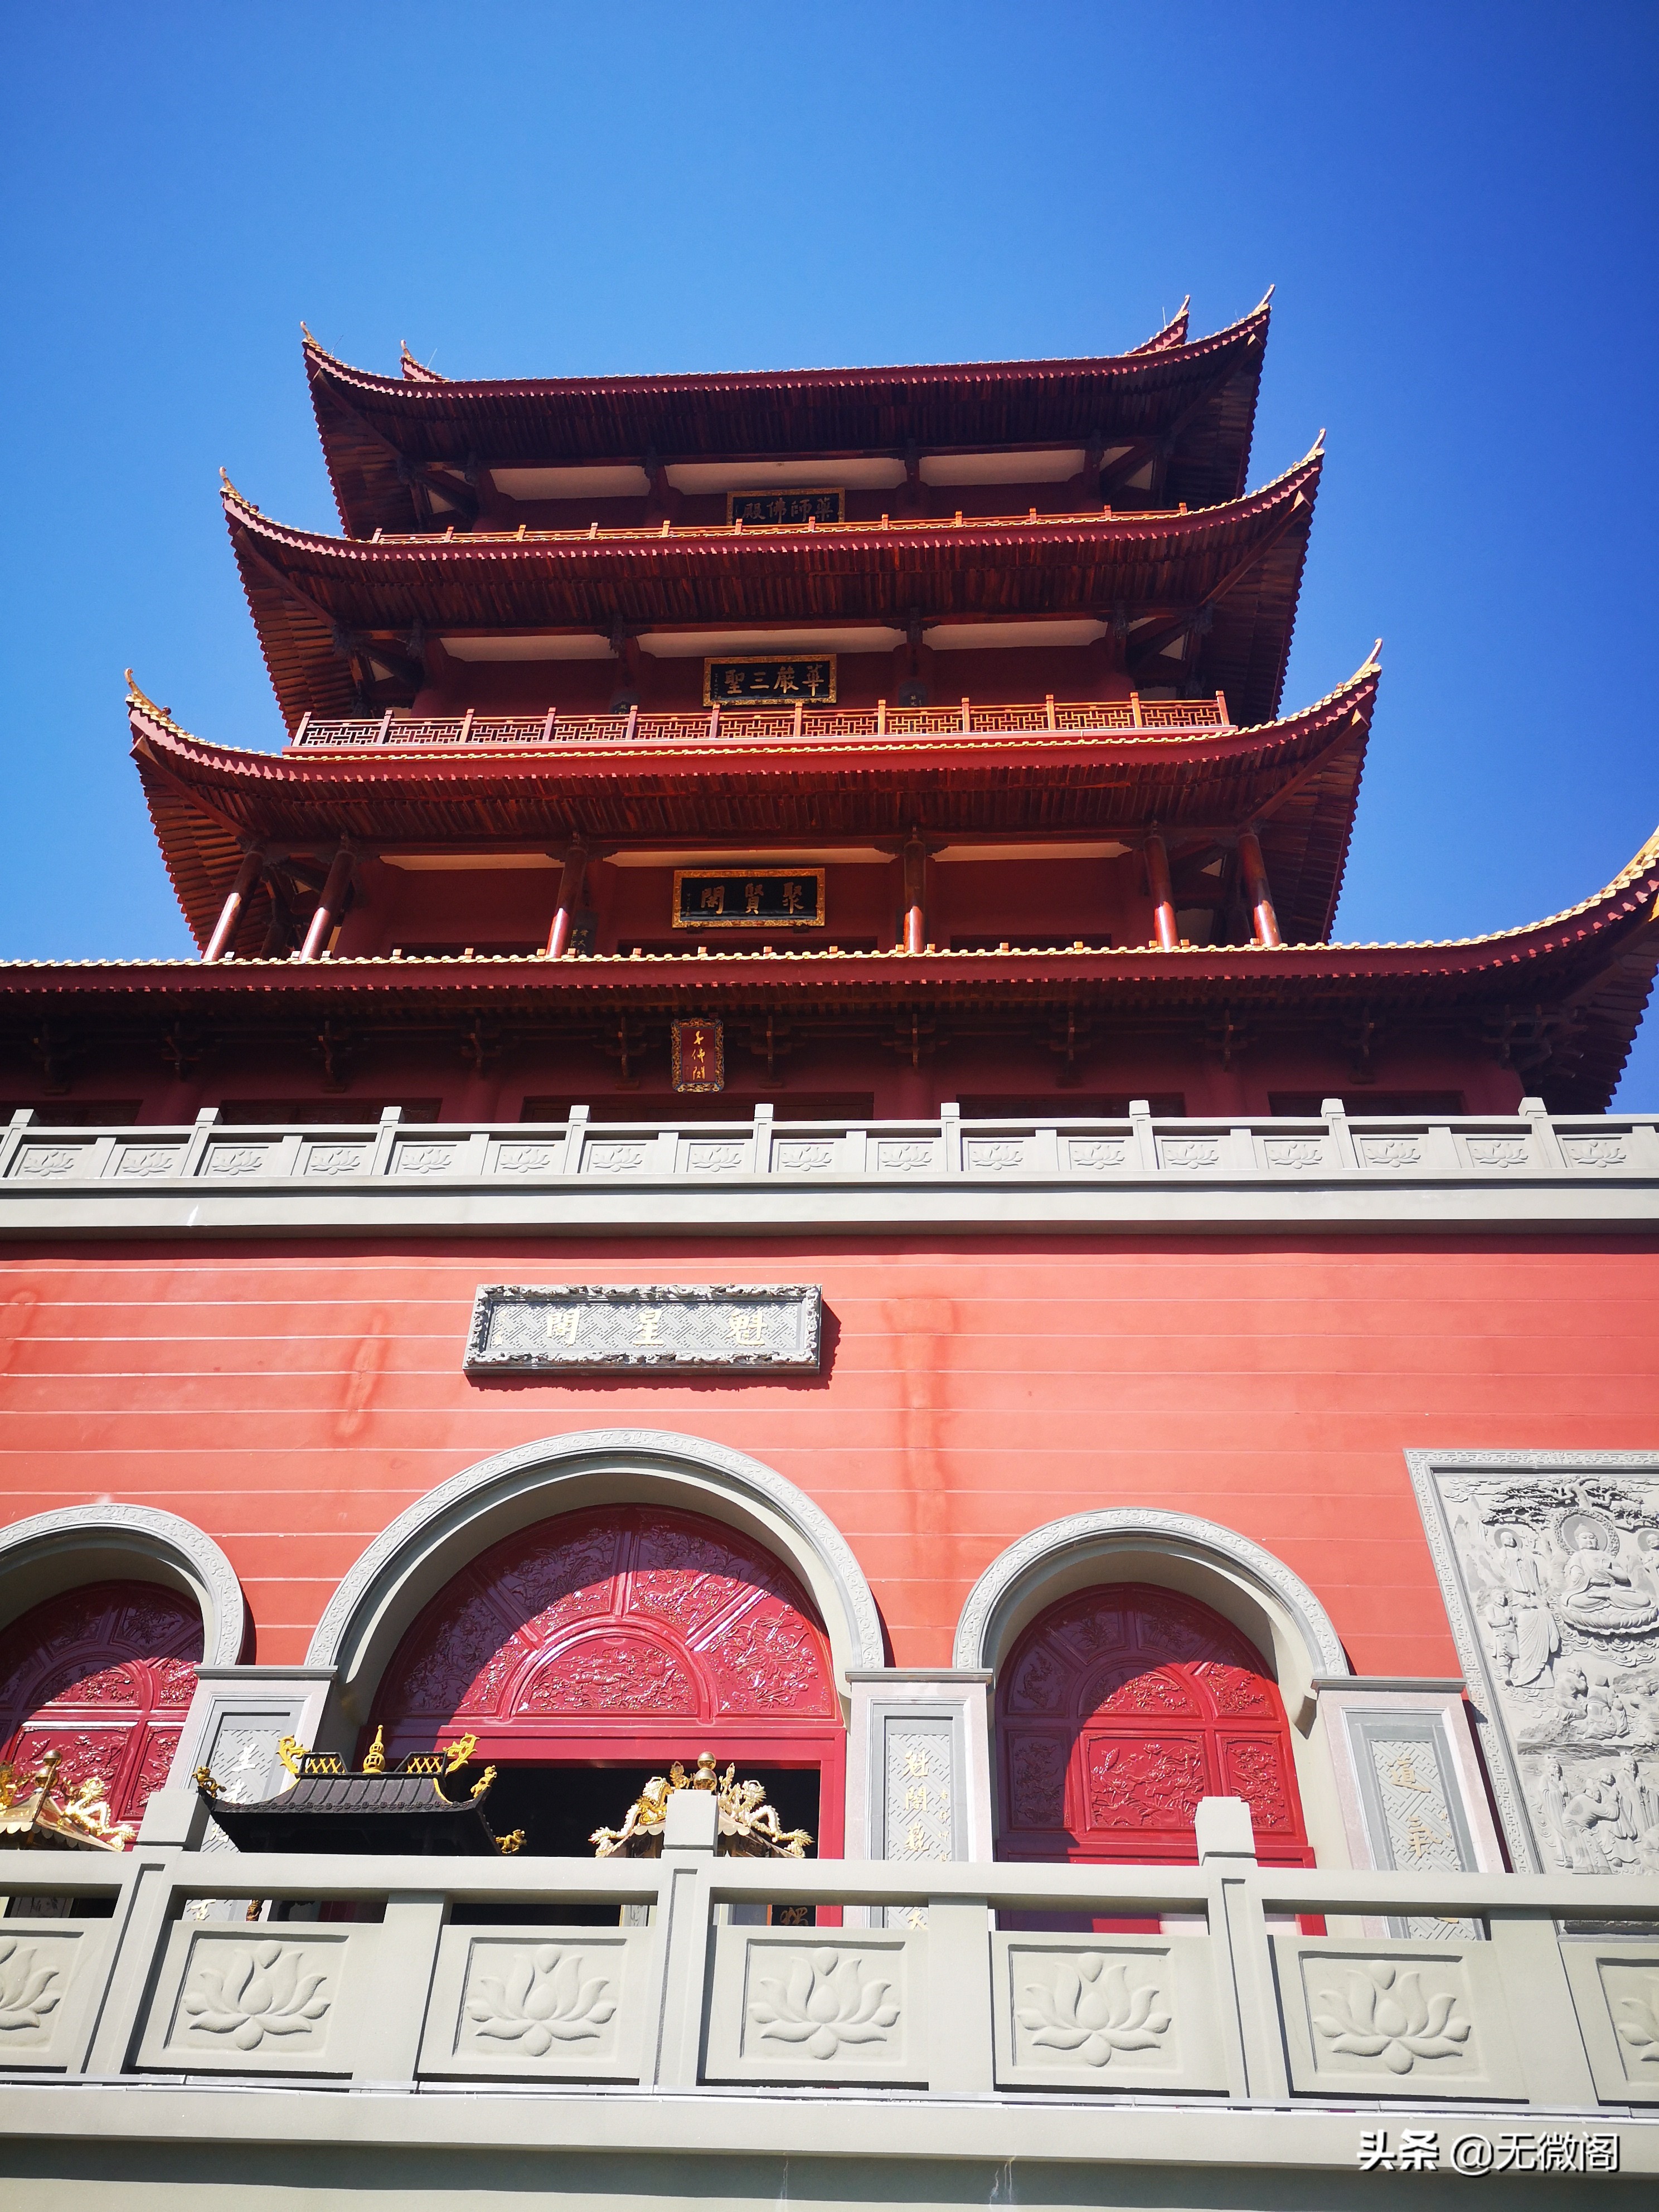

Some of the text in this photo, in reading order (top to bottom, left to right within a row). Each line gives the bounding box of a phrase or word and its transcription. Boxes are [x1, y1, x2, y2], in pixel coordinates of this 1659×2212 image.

[725, 663, 824, 697] 華嚴三聖
[546, 1308, 768, 1346] 魁星閣
